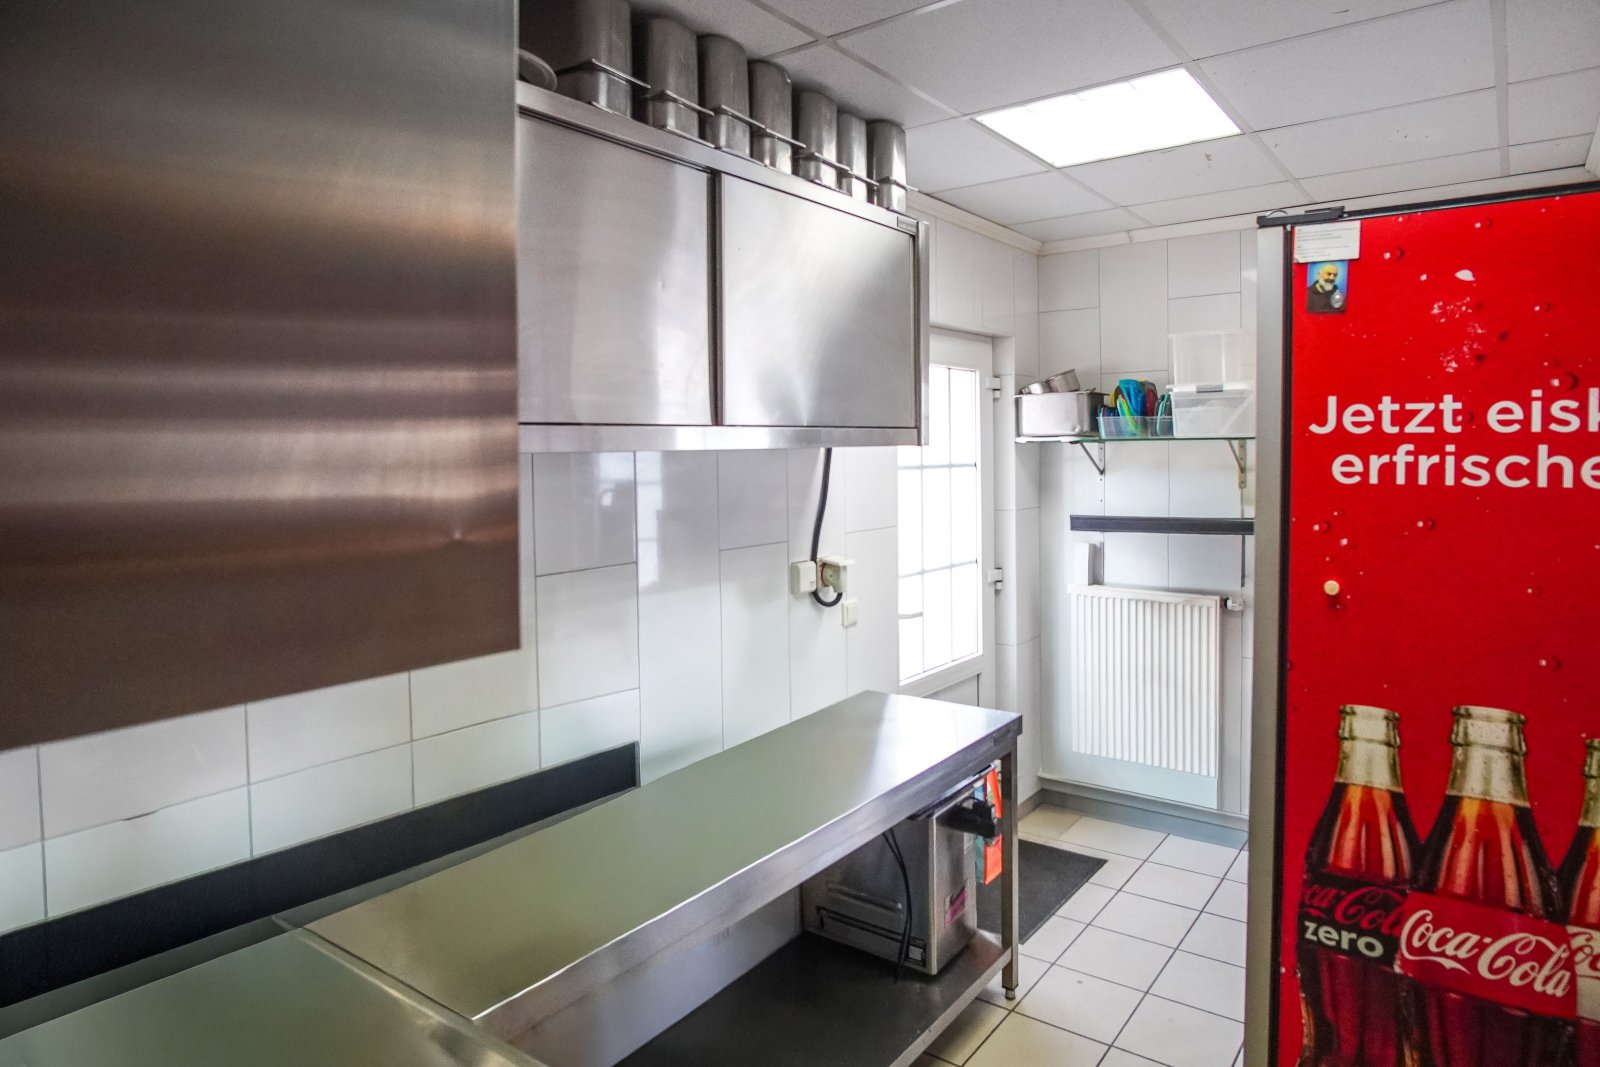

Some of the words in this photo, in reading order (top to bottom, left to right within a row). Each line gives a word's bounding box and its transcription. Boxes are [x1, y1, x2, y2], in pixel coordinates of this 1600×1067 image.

[1308, 395, 1462, 434] Jetzt
[1304, 920, 1384, 957] zero
[1400, 909, 1570, 998] Coca-Cola
